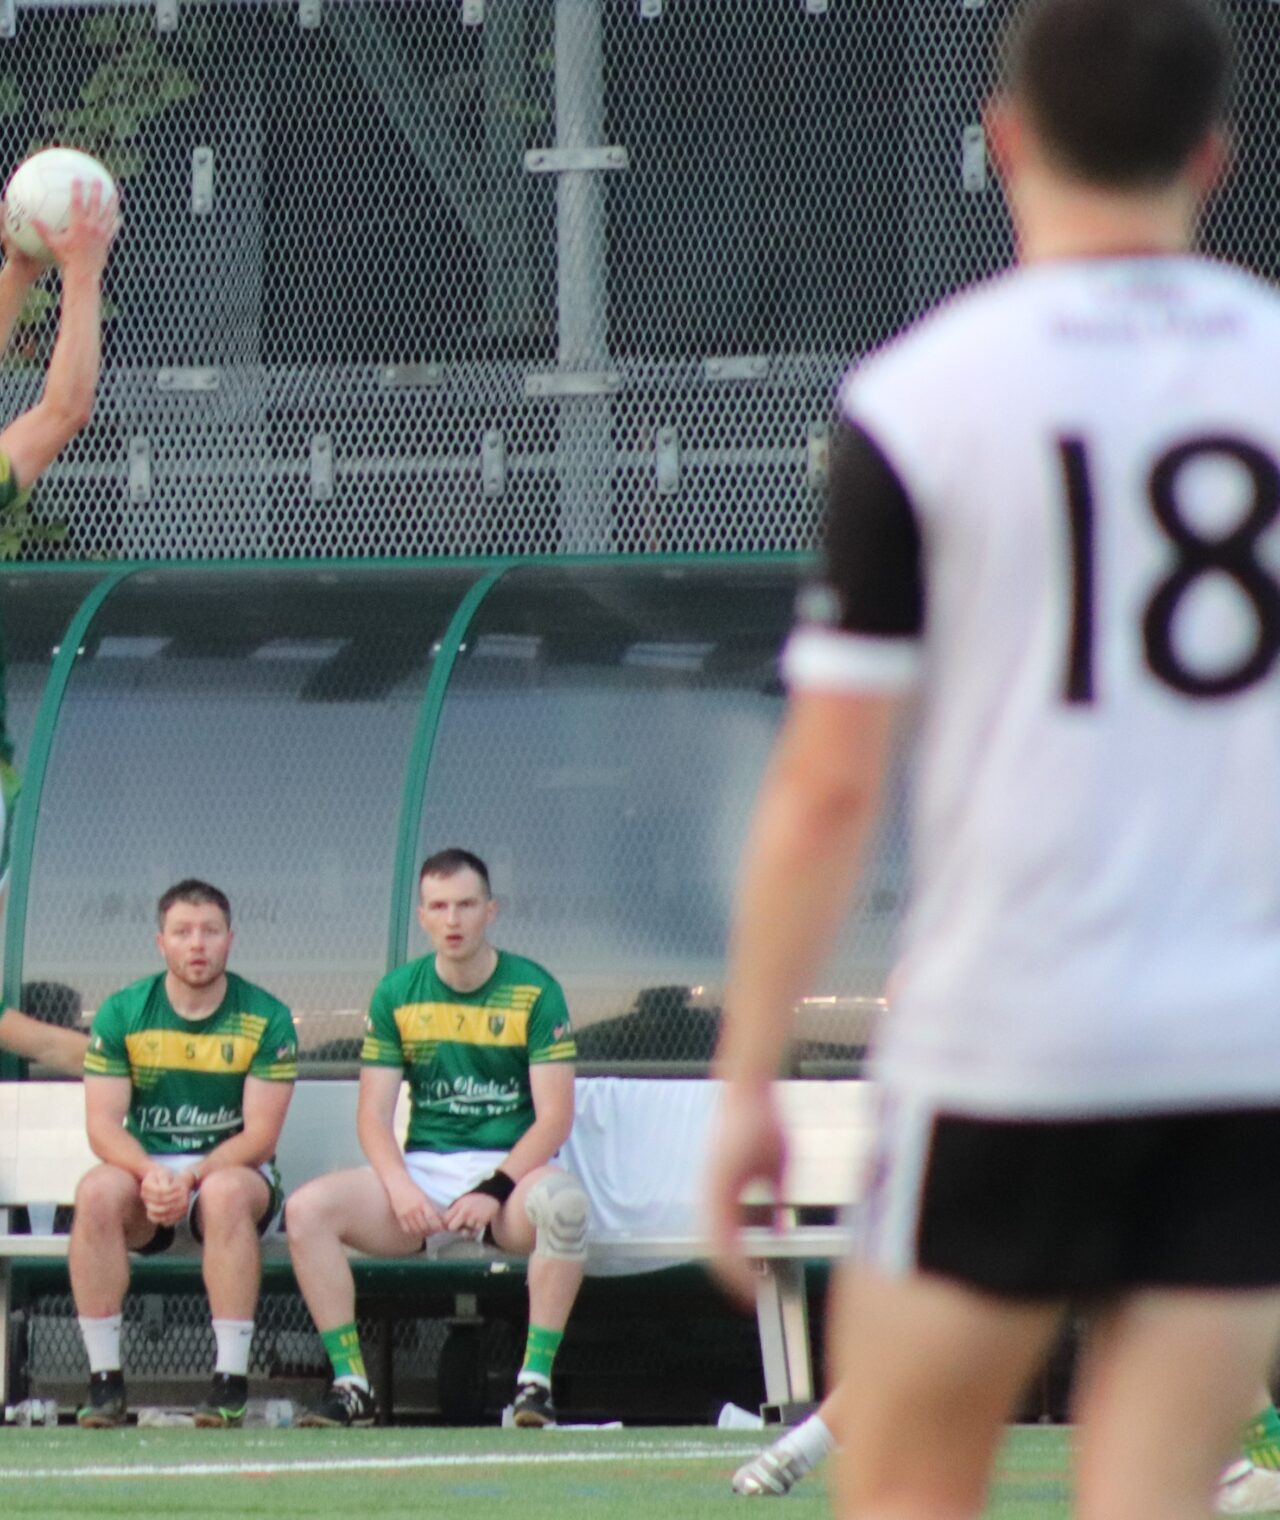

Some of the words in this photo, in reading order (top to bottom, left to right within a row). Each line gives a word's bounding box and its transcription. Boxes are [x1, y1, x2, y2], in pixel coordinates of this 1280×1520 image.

[1056, 435, 1280, 704] 18
[456, 1015, 465, 1031] 7
[175, 1103, 237, 1126] Clarke
[448, 1101, 481, 1115] New
